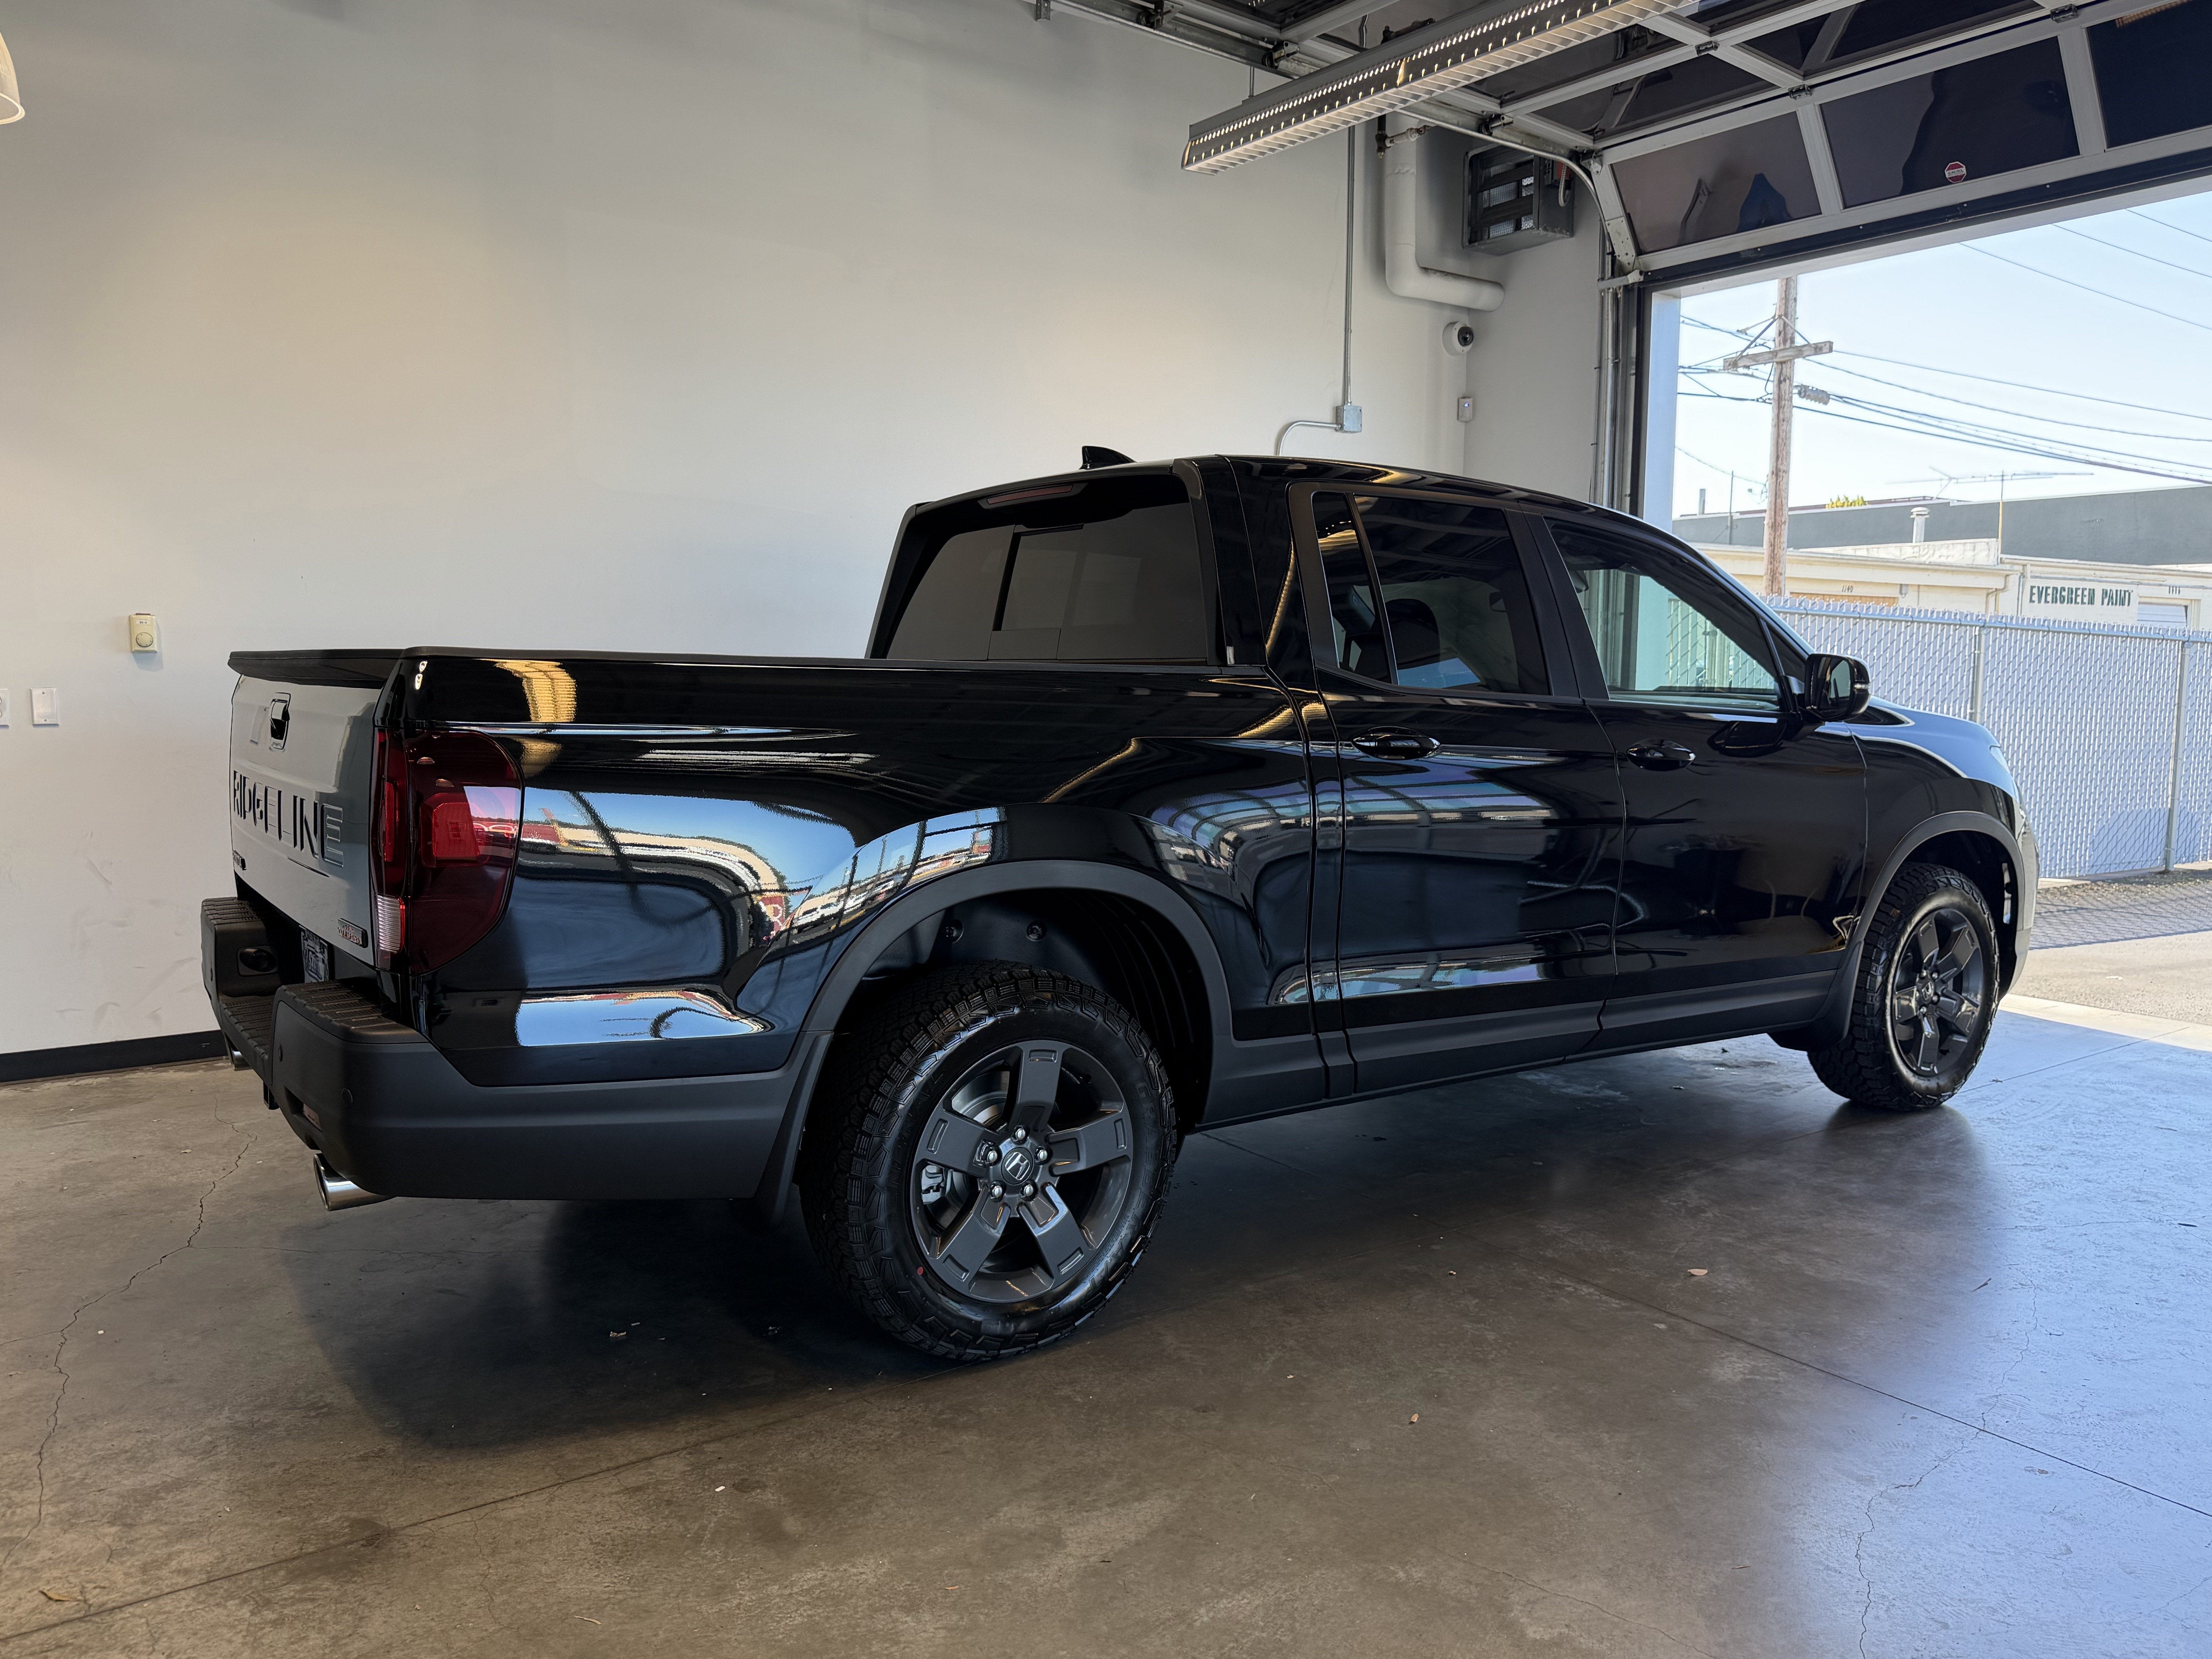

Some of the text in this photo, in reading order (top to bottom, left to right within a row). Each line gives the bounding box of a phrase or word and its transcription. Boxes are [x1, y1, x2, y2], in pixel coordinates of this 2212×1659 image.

[2029, 586, 2133, 606] EVERGREEN PAINT
[234, 770, 344, 867] RIDGELINE
